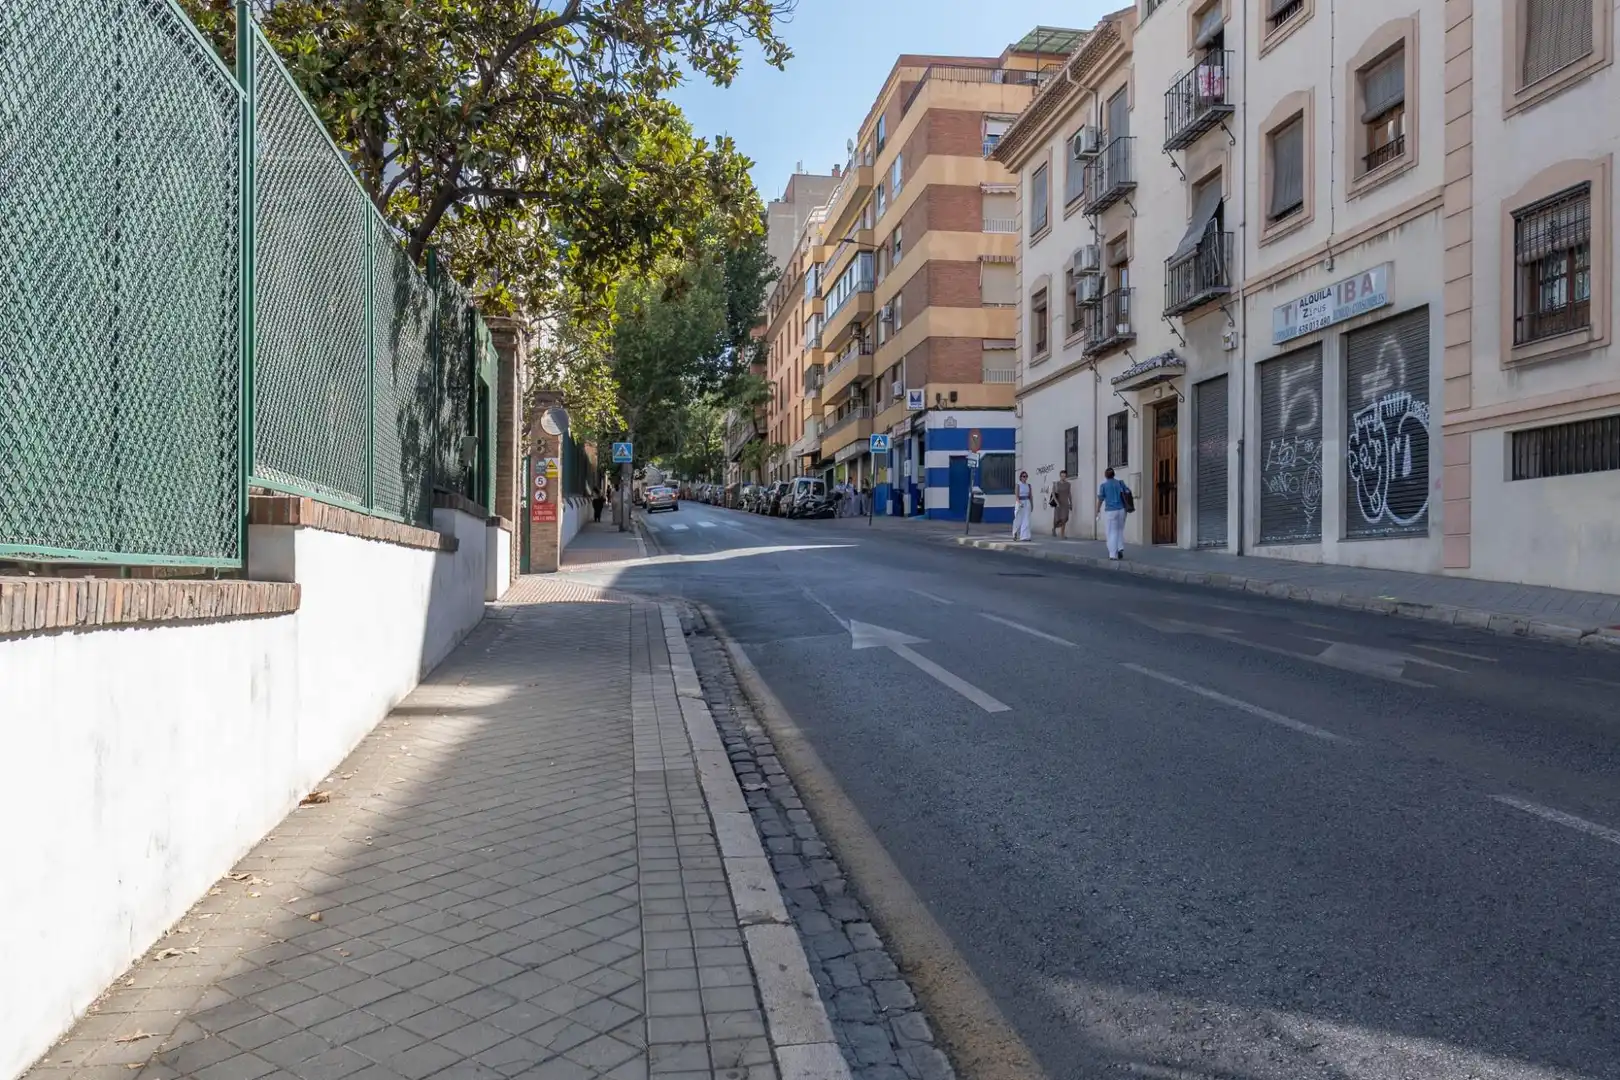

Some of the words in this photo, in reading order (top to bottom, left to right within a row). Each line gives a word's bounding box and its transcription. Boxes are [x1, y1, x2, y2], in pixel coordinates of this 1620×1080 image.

[1299, 288, 1332, 308] ALQUILA
[1309, 320, 1320, 331] 013
[537, 477, 543, 486] 5
